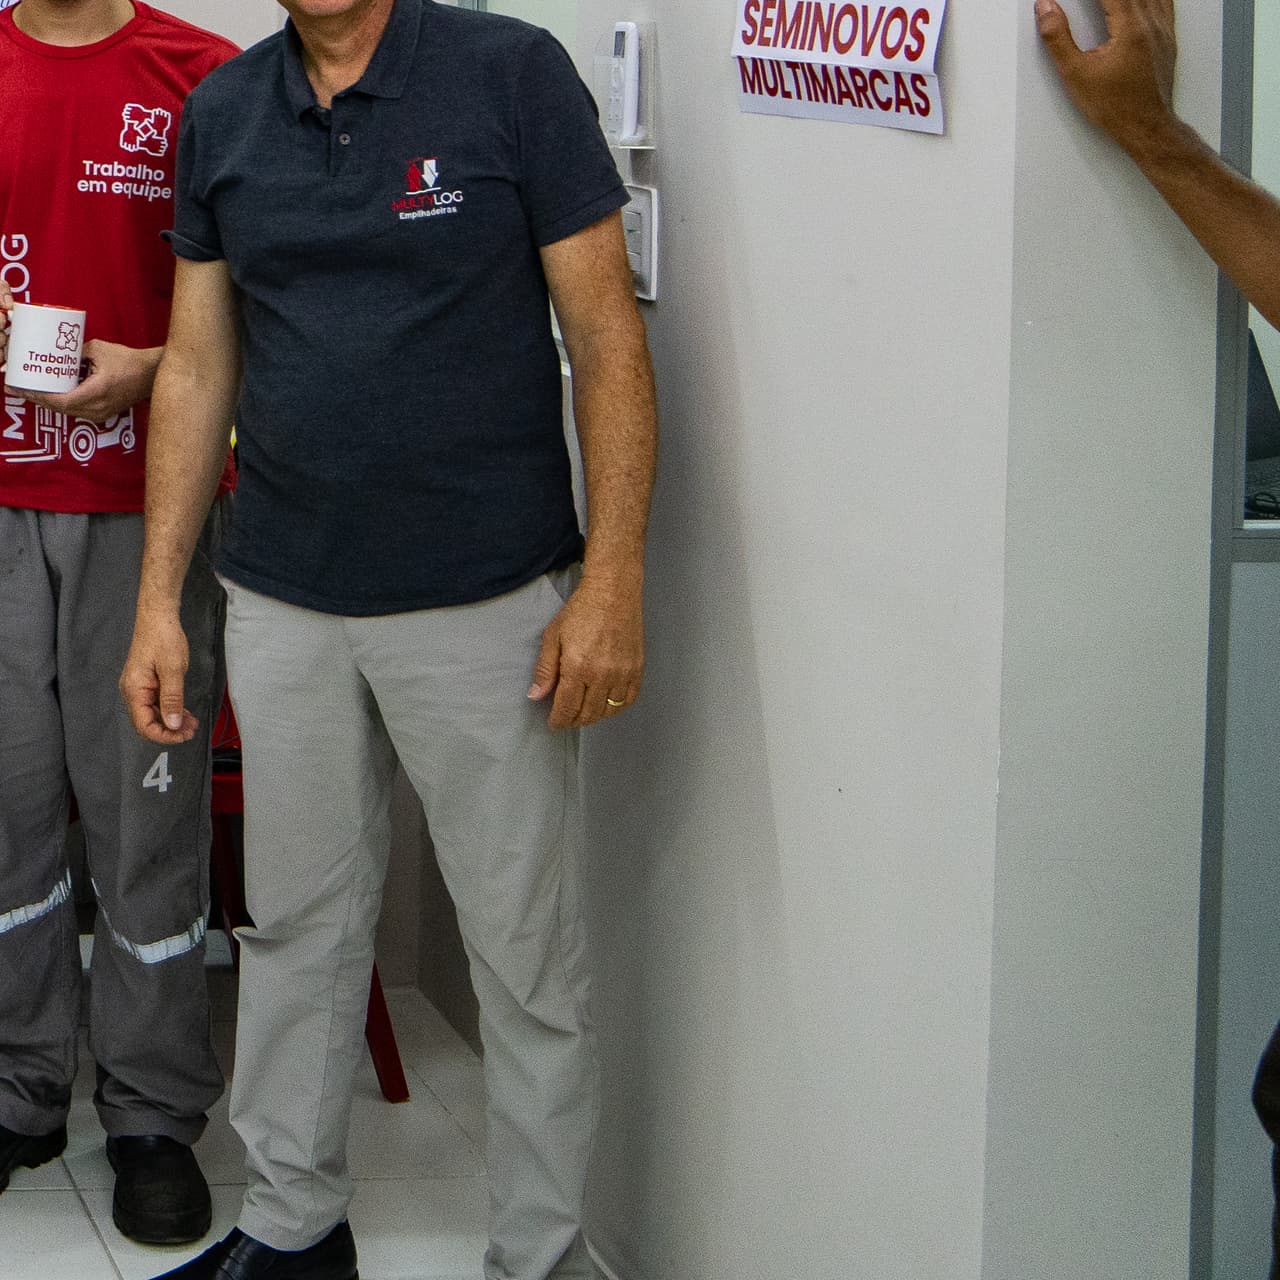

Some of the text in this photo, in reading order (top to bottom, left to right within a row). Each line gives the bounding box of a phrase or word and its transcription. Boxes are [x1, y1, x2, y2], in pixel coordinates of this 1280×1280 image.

[737, 55, 931, 118] MULTIMARCAS
[82, 160, 165, 182] Trabalho
[77, 180, 172, 202] em equipe
[392, 191, 464, 211] MULTYLOG
[399, 205, 458, 220] Empilhadeiras
[22, 363, 42, 373] em
[28, 350, 78, 365] Trabalho
[142, 751, 173, 793] 4
